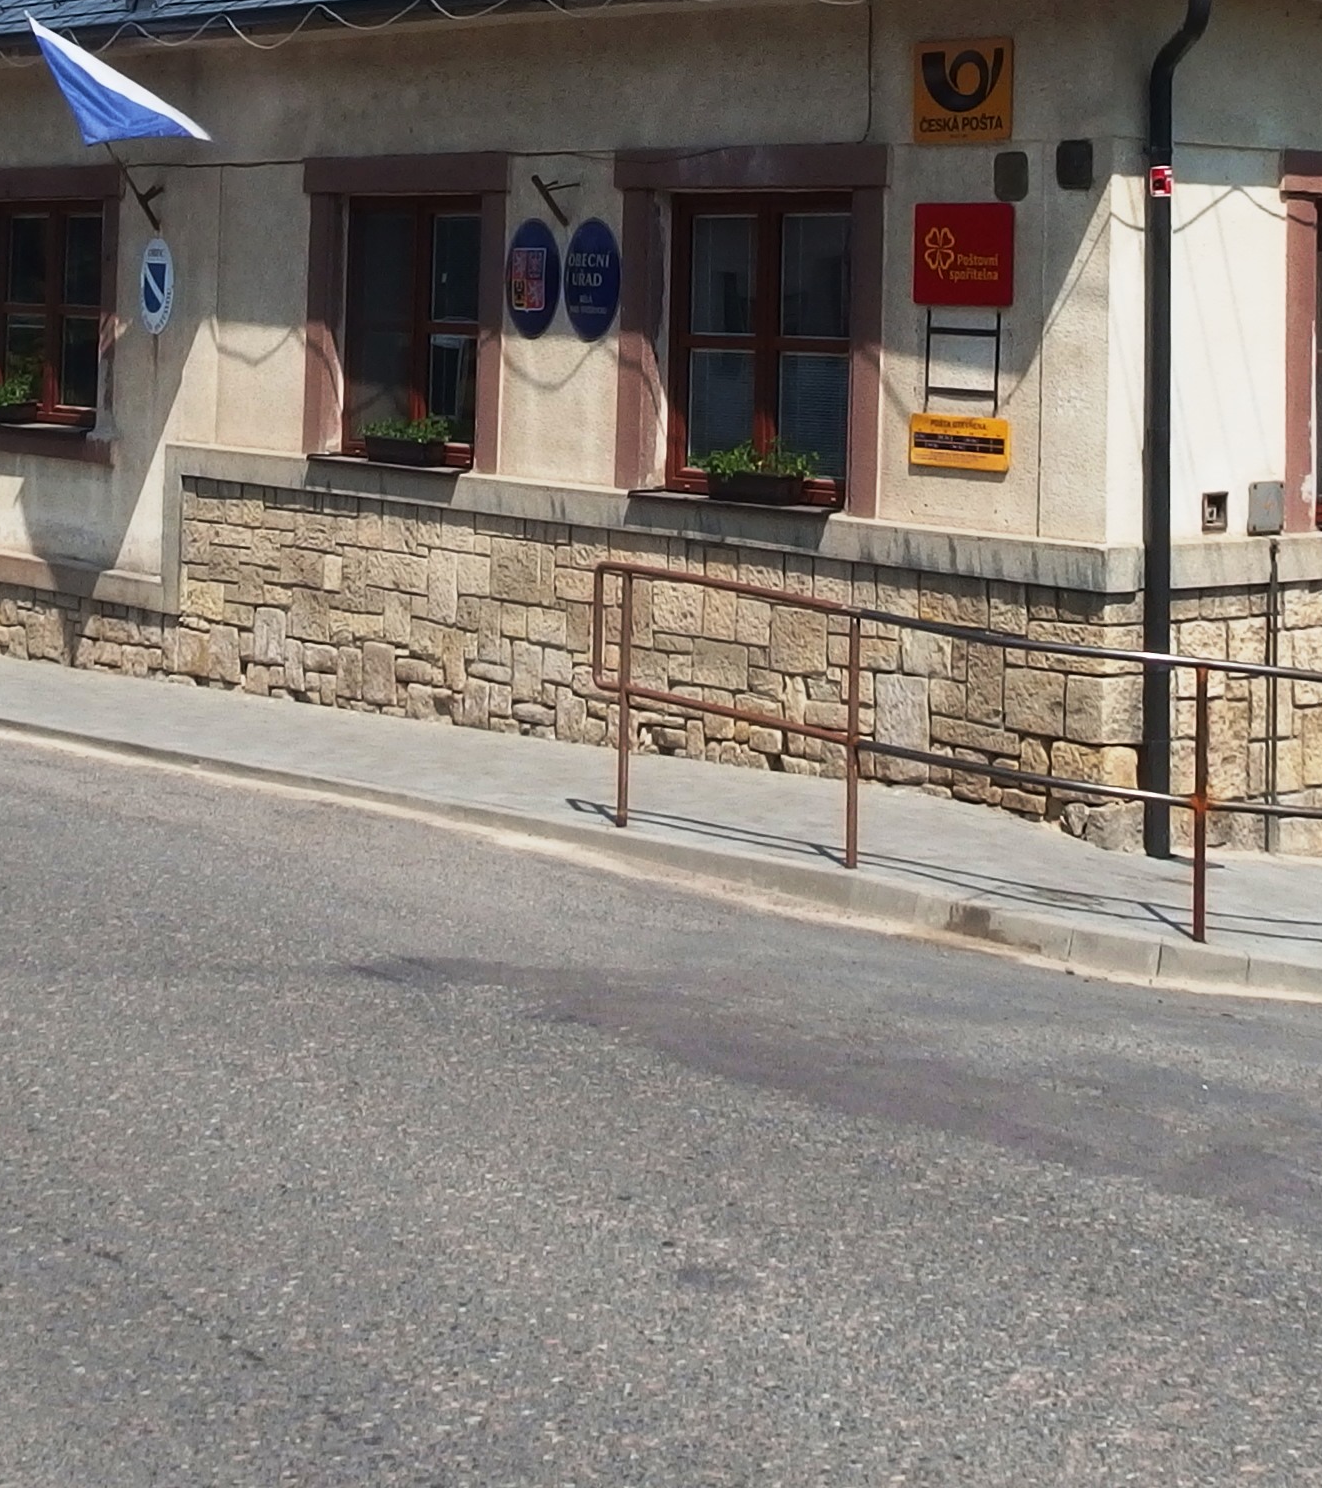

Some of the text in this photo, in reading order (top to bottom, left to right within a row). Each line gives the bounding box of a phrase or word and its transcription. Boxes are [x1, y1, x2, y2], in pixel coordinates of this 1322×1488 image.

[919, 113, 1003, 133] ČESKÁ POŠTA
[568, 251, 610, 268] OBECNÍ
[957, 253, 999, 267] Poštovní
[949, 268, 999, 283] spořitelna
